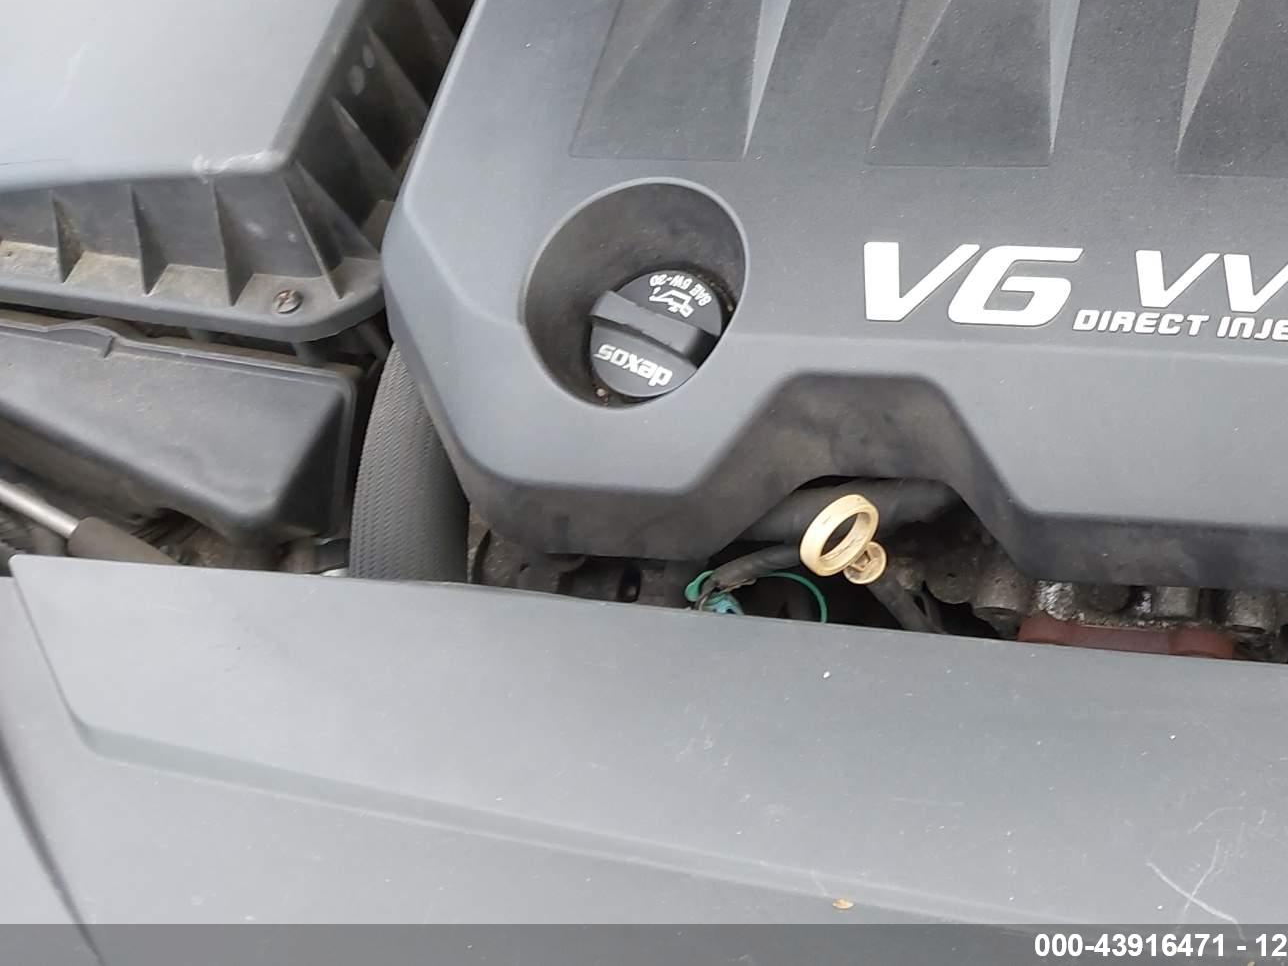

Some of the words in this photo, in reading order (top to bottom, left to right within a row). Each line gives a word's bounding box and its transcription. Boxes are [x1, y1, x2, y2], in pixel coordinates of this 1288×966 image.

[689, 283, 713, 307] SAE
[863, 241, 1083, 326] V6
[1073, 309, 1210, 336] DIRECT
[593, 343, 674, 387] dexos
